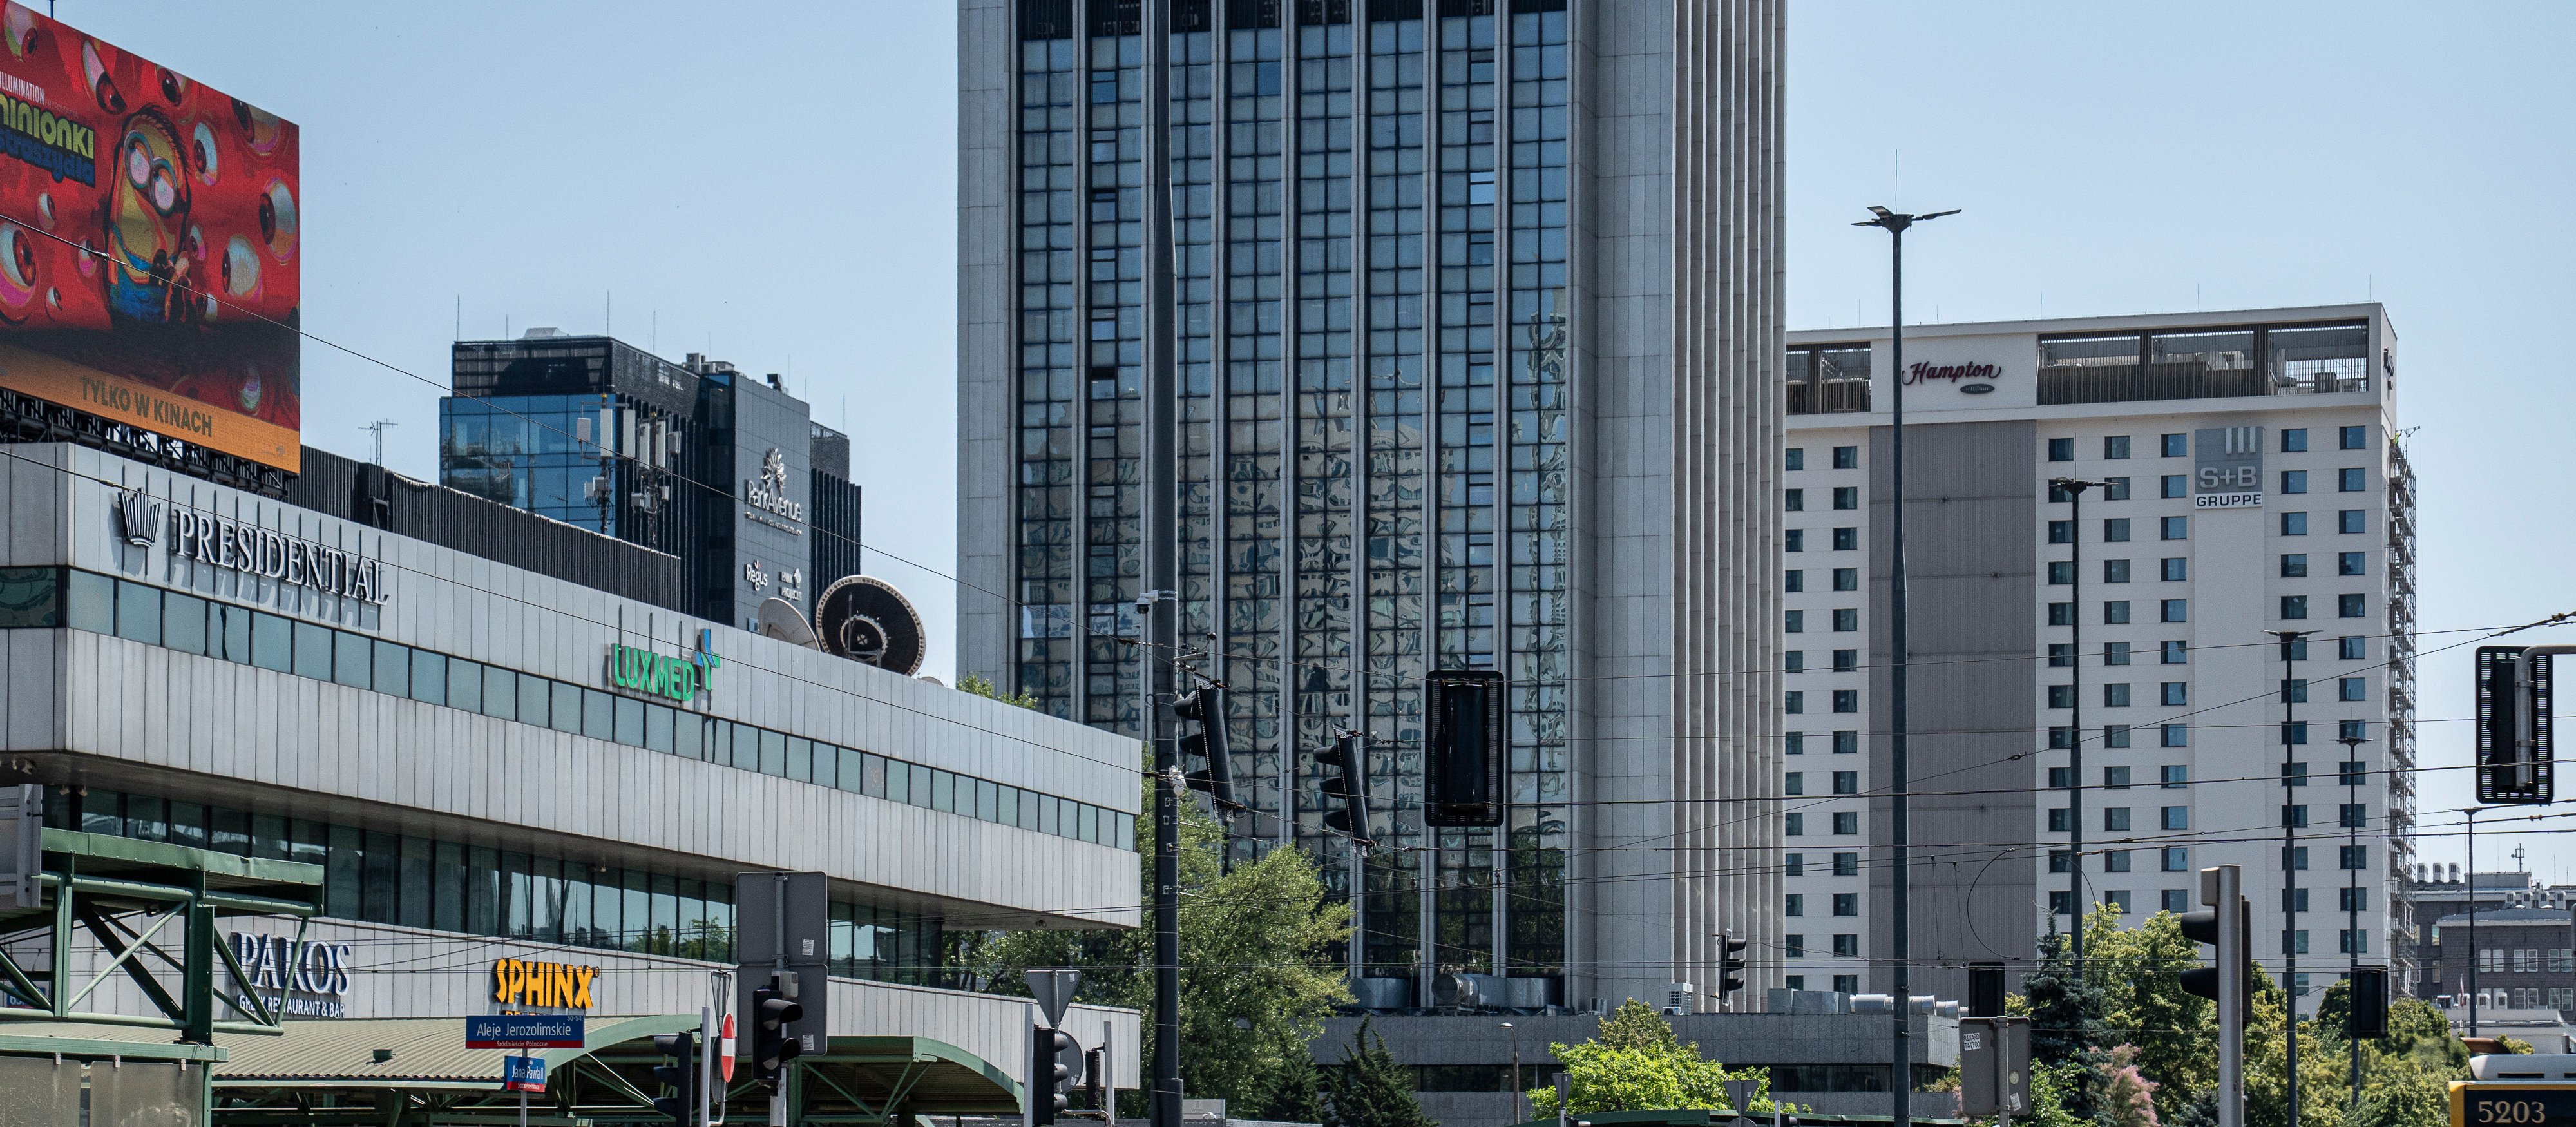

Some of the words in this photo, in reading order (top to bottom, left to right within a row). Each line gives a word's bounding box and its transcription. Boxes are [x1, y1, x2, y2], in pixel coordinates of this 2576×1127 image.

[1902, 361, 2001, 385] Hampton
[80, 376, 131, 412] TYLKO
[135, 392, 150, 418] W
[154, 398, 212, 438] KINACH
[2200, 466, 2256, 488] S+B
[2197, 494, 2262, 506] GRUPPE
[173, 508, 389, 606] PRESIDENTIAL
[747, 564, 768, 592] Regus
[613, 643, 695, 701] LUXMED
[496, 958, 594, 1009] SPHINX
[268, 997, 321, 1016] REAURANT
[321, 1001, 328, 1017] &
[329, 1002, 345, 1018] BAR
[477, 1023, 501, 1040] Aleje
[506, 1022, 571, 1037] Jerozolimskie
[512, 1065, 525, 1078] Jana
[527, 1066, 540, 1079] Pawła
[2478, 1101, 2546, 1124] 5203
